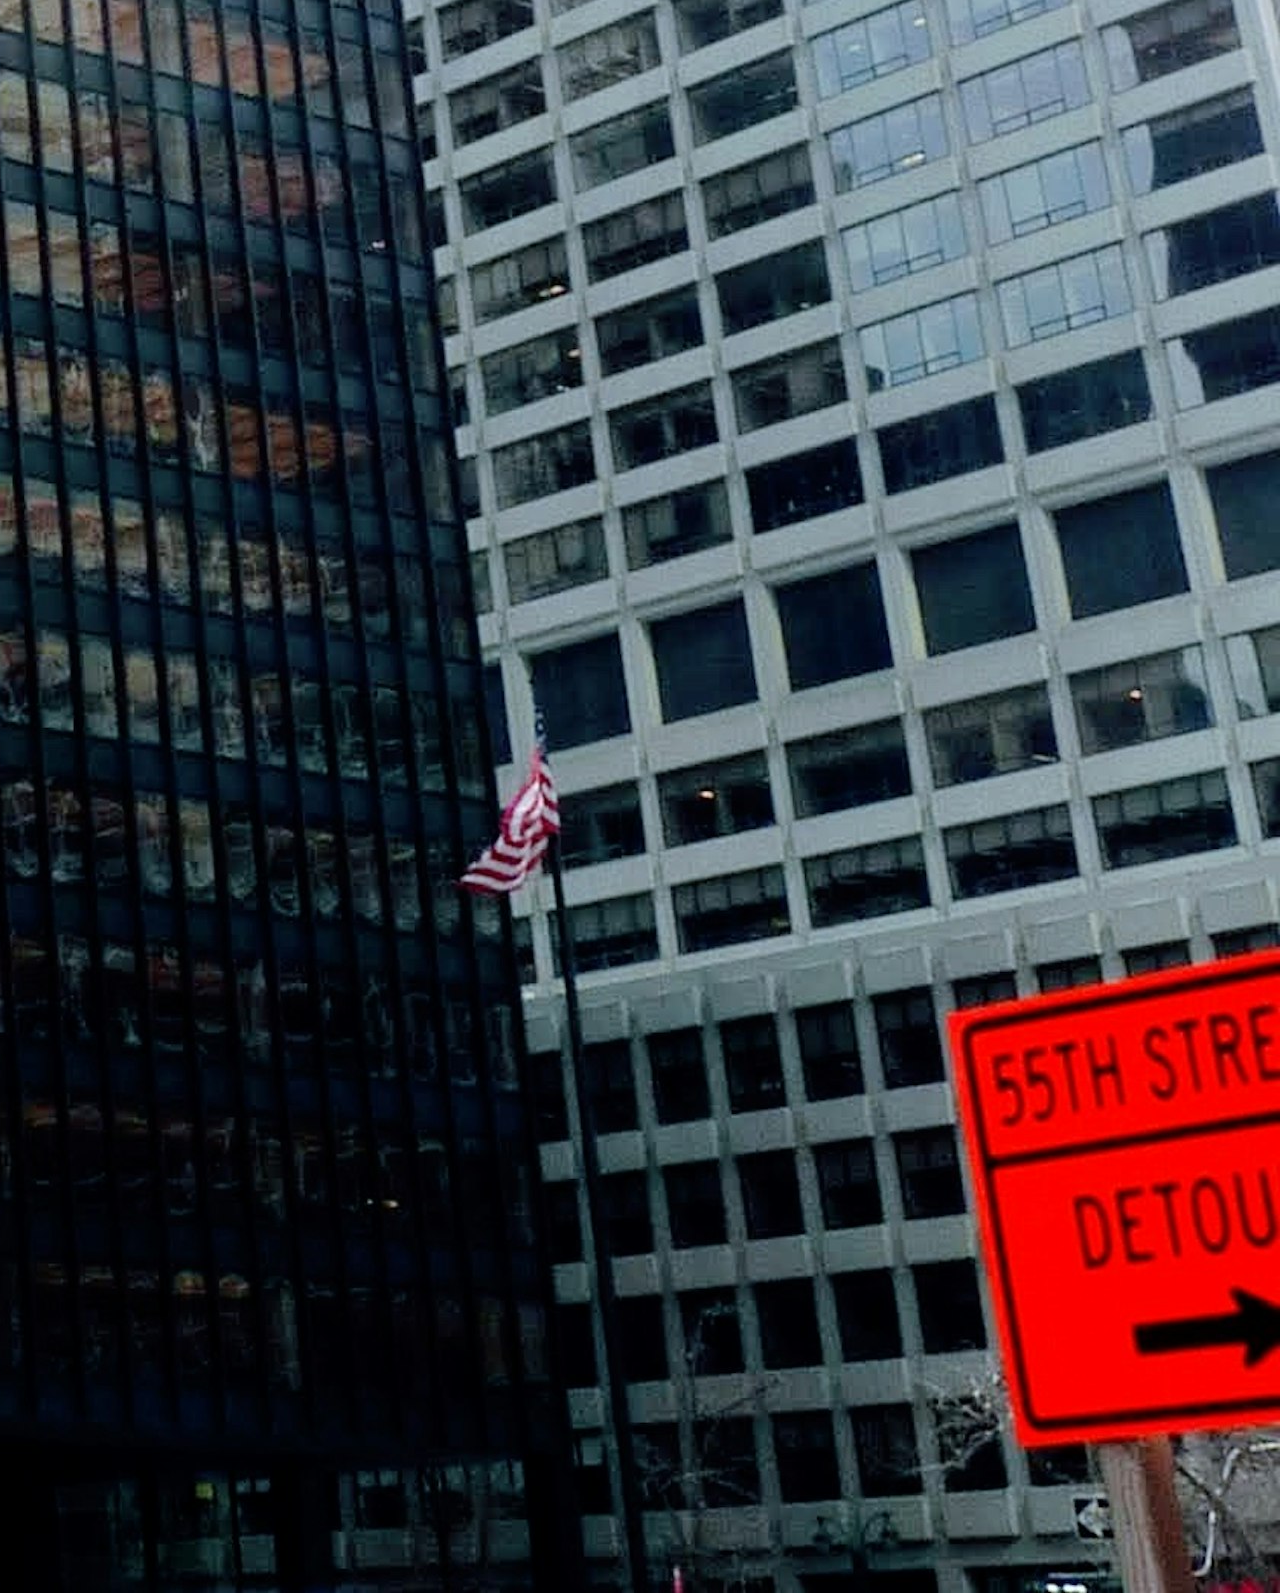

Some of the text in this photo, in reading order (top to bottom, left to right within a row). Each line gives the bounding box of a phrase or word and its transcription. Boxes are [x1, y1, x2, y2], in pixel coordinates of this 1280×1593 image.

[992, 1004, 1280, 1128] 55TH STRE
[1073, 1168, 1279, 1271] DETOU
